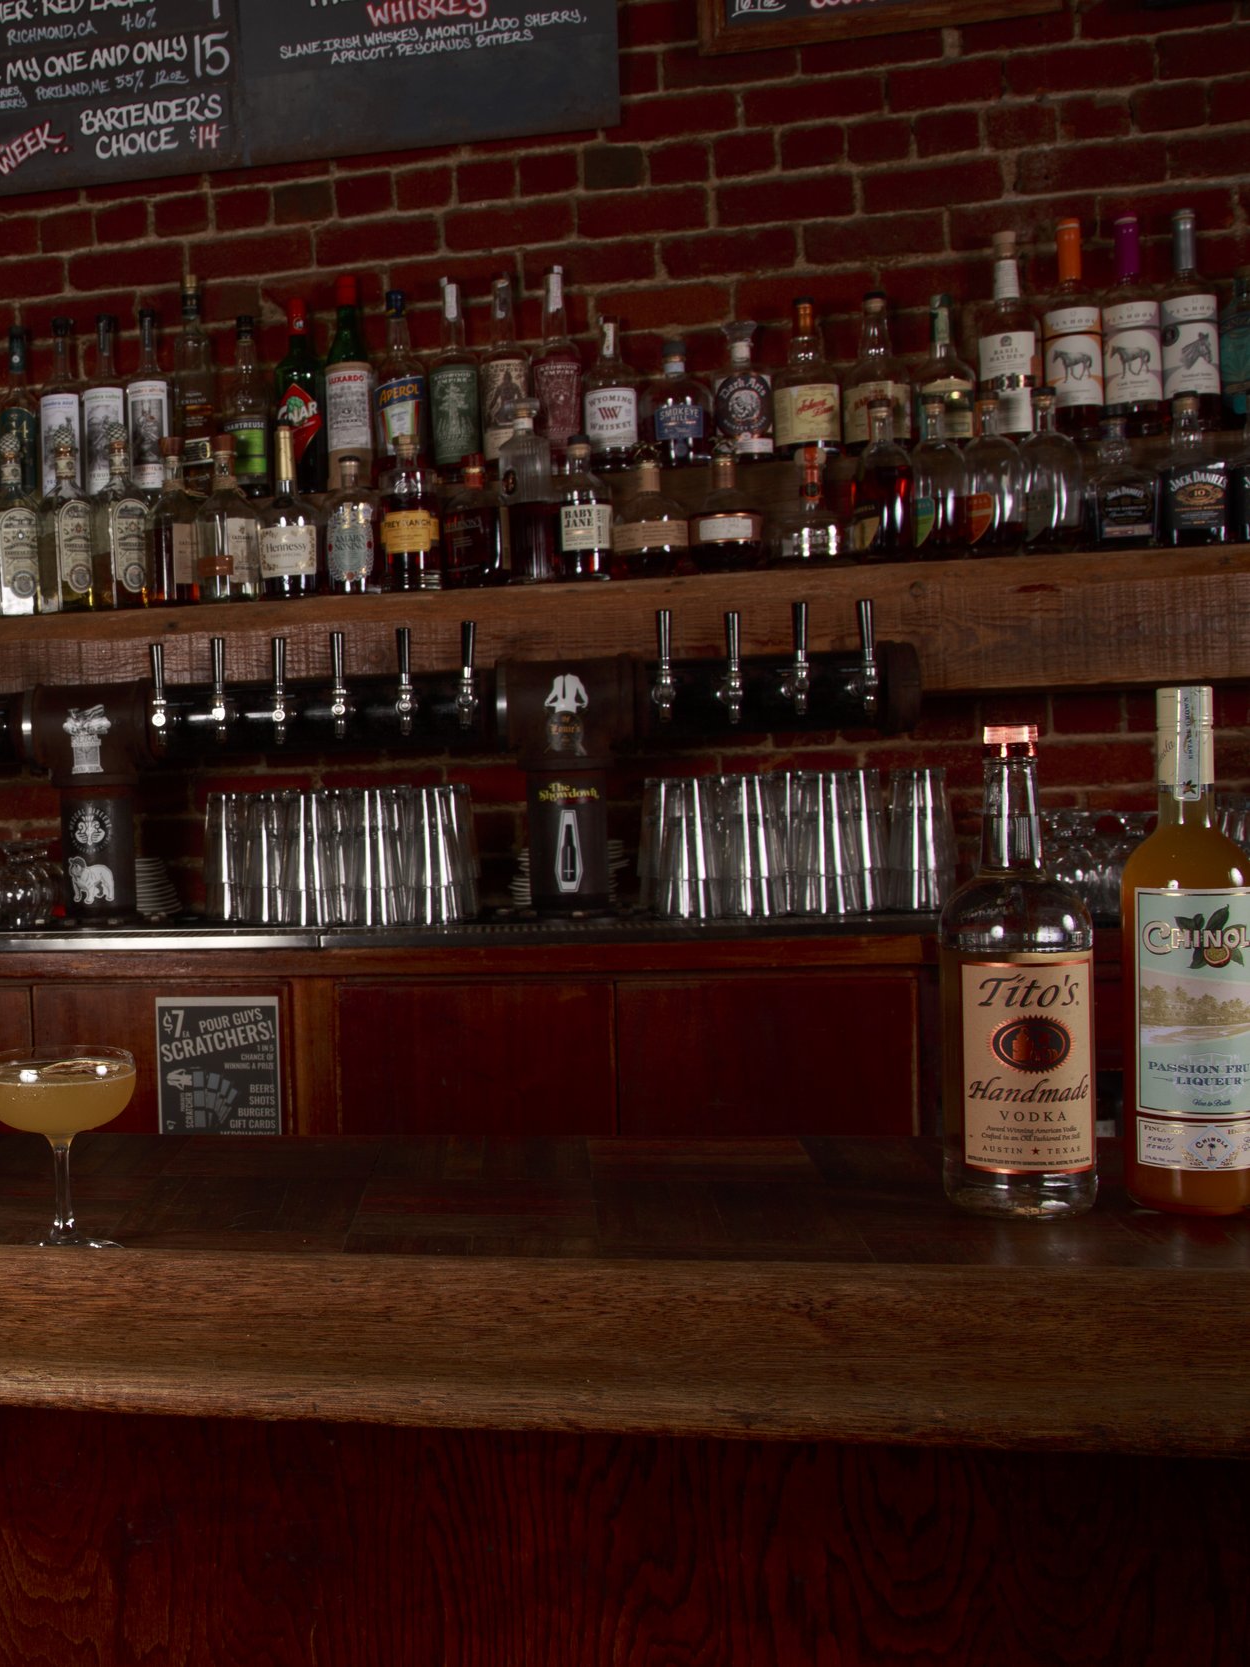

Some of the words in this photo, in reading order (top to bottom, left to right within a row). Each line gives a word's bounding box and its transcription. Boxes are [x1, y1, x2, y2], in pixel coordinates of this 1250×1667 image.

[280, 40, 322, 60] SLANE
[323, 34, 360, 52] IRISH
[424, 17, 520, 40] AMONTILLADO
[475, 29, 534, 49] BITTERS
[6, 56, 41, 85] MY
[44, 51, 90, 78] ONE
[90, 43, 130, 70] AND
[132, 34, 188, 64] ONLY
[194, 30, 231, 78] 15
[79, 93, 222, 135] BARTENDER'S
[95, 126, 179, 160] CHOICE
[329, 375, 364, 385] LUXARDO
[379, 383, 419, 407] APEROL
[589, 395, 632, 407] WYOMING
[659, 408, 699, 420] SMOKEYE
[590, 421, 632, 431] WHISKEY
[1170, 474, 1192, 492] JACK
[564, 509, 593, 519] BABY
[565, 518, 593, 528] JANE
[266, 541, 307, 553] Hennessy
[1142, 920, 1250, 956] CHINOL
[163, 1010, 185, 1038] $7
[198, 1015, 231, 1034] POUR
[232, 1008, 263, 1026] GUYS
[160, 1020, 276, 1063] SCRATCHERS!
[240, 1053, 266, 1061] CHANCE
[224, 1062, 251, 1070] WINNING
[1148, 1061, 1219, 1074] PASSION
[1176, 1076, 1242, 1087] LIQUEUR
[250, 1084, 275, 1093] BEERS
[968, 1074, 1089, 1104] Handmade
[249, 1095, 276, 1105] SHOTS
[238, 1107, 276, 1118] BURGERS
[999, 1110, 1067, 1122] VODKA
[230, 1119, 247, 1129] GIFT
[248, 1119, 276, 1129] CARDS
[982, 1145, 1023, 1154] AUSTIN
[1047, 1145, 1081, 1154] TEXAS
